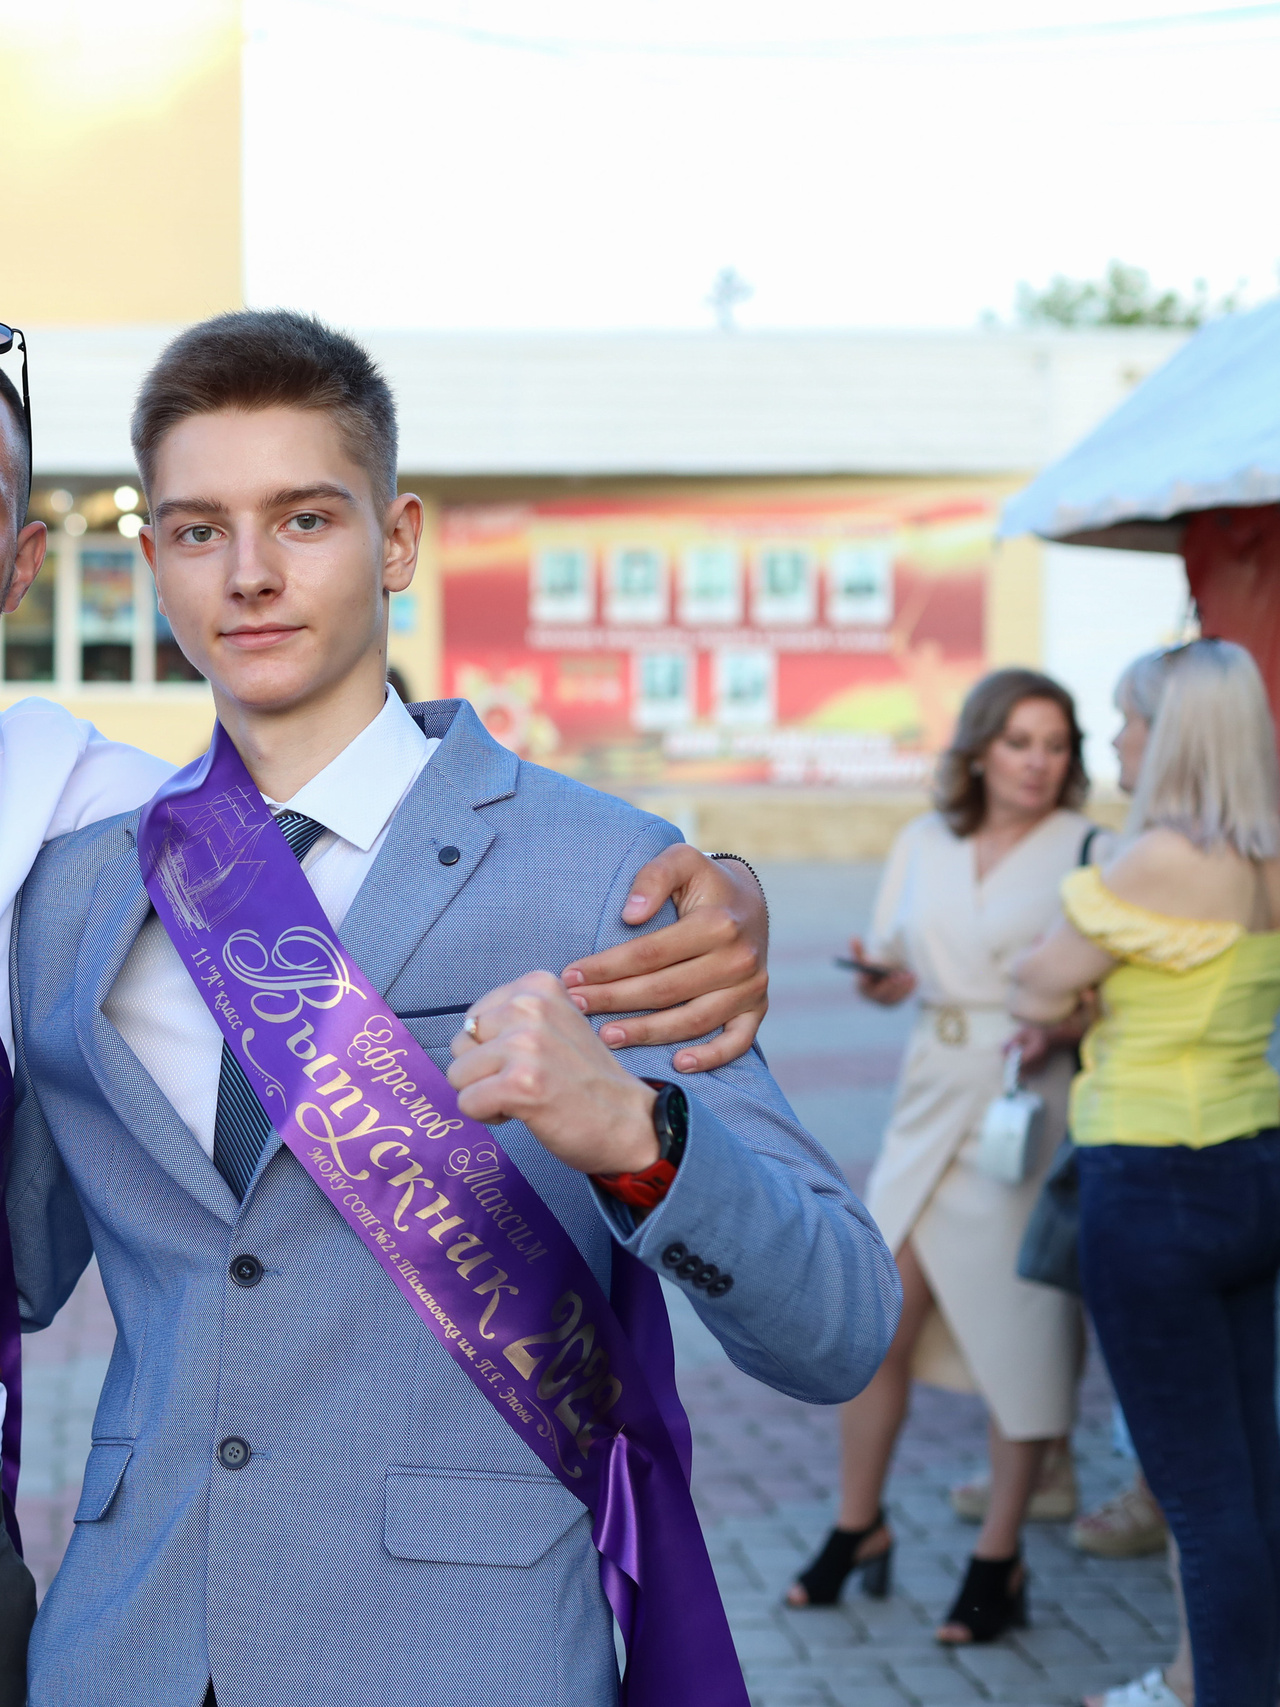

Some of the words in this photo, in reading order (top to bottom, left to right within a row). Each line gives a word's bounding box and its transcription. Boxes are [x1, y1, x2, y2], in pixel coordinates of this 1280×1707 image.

[191, 947, 208, 967] 11
[214, 990, 243, 1030] класс
[222, 926, 519, 1340] Выпускник
[347, 1015, 463, 1139] Ефремов
[443, 1142, 548, 1264] Максим
[307, 1146, 354, 1191] МОАУ
[342, 1193, 381, 1229] СОШ
[370, 1226, 396, 1252] №2
[458, 1337, 475, 1361] им.
[498, 1386, 534, 1424] Эпова
